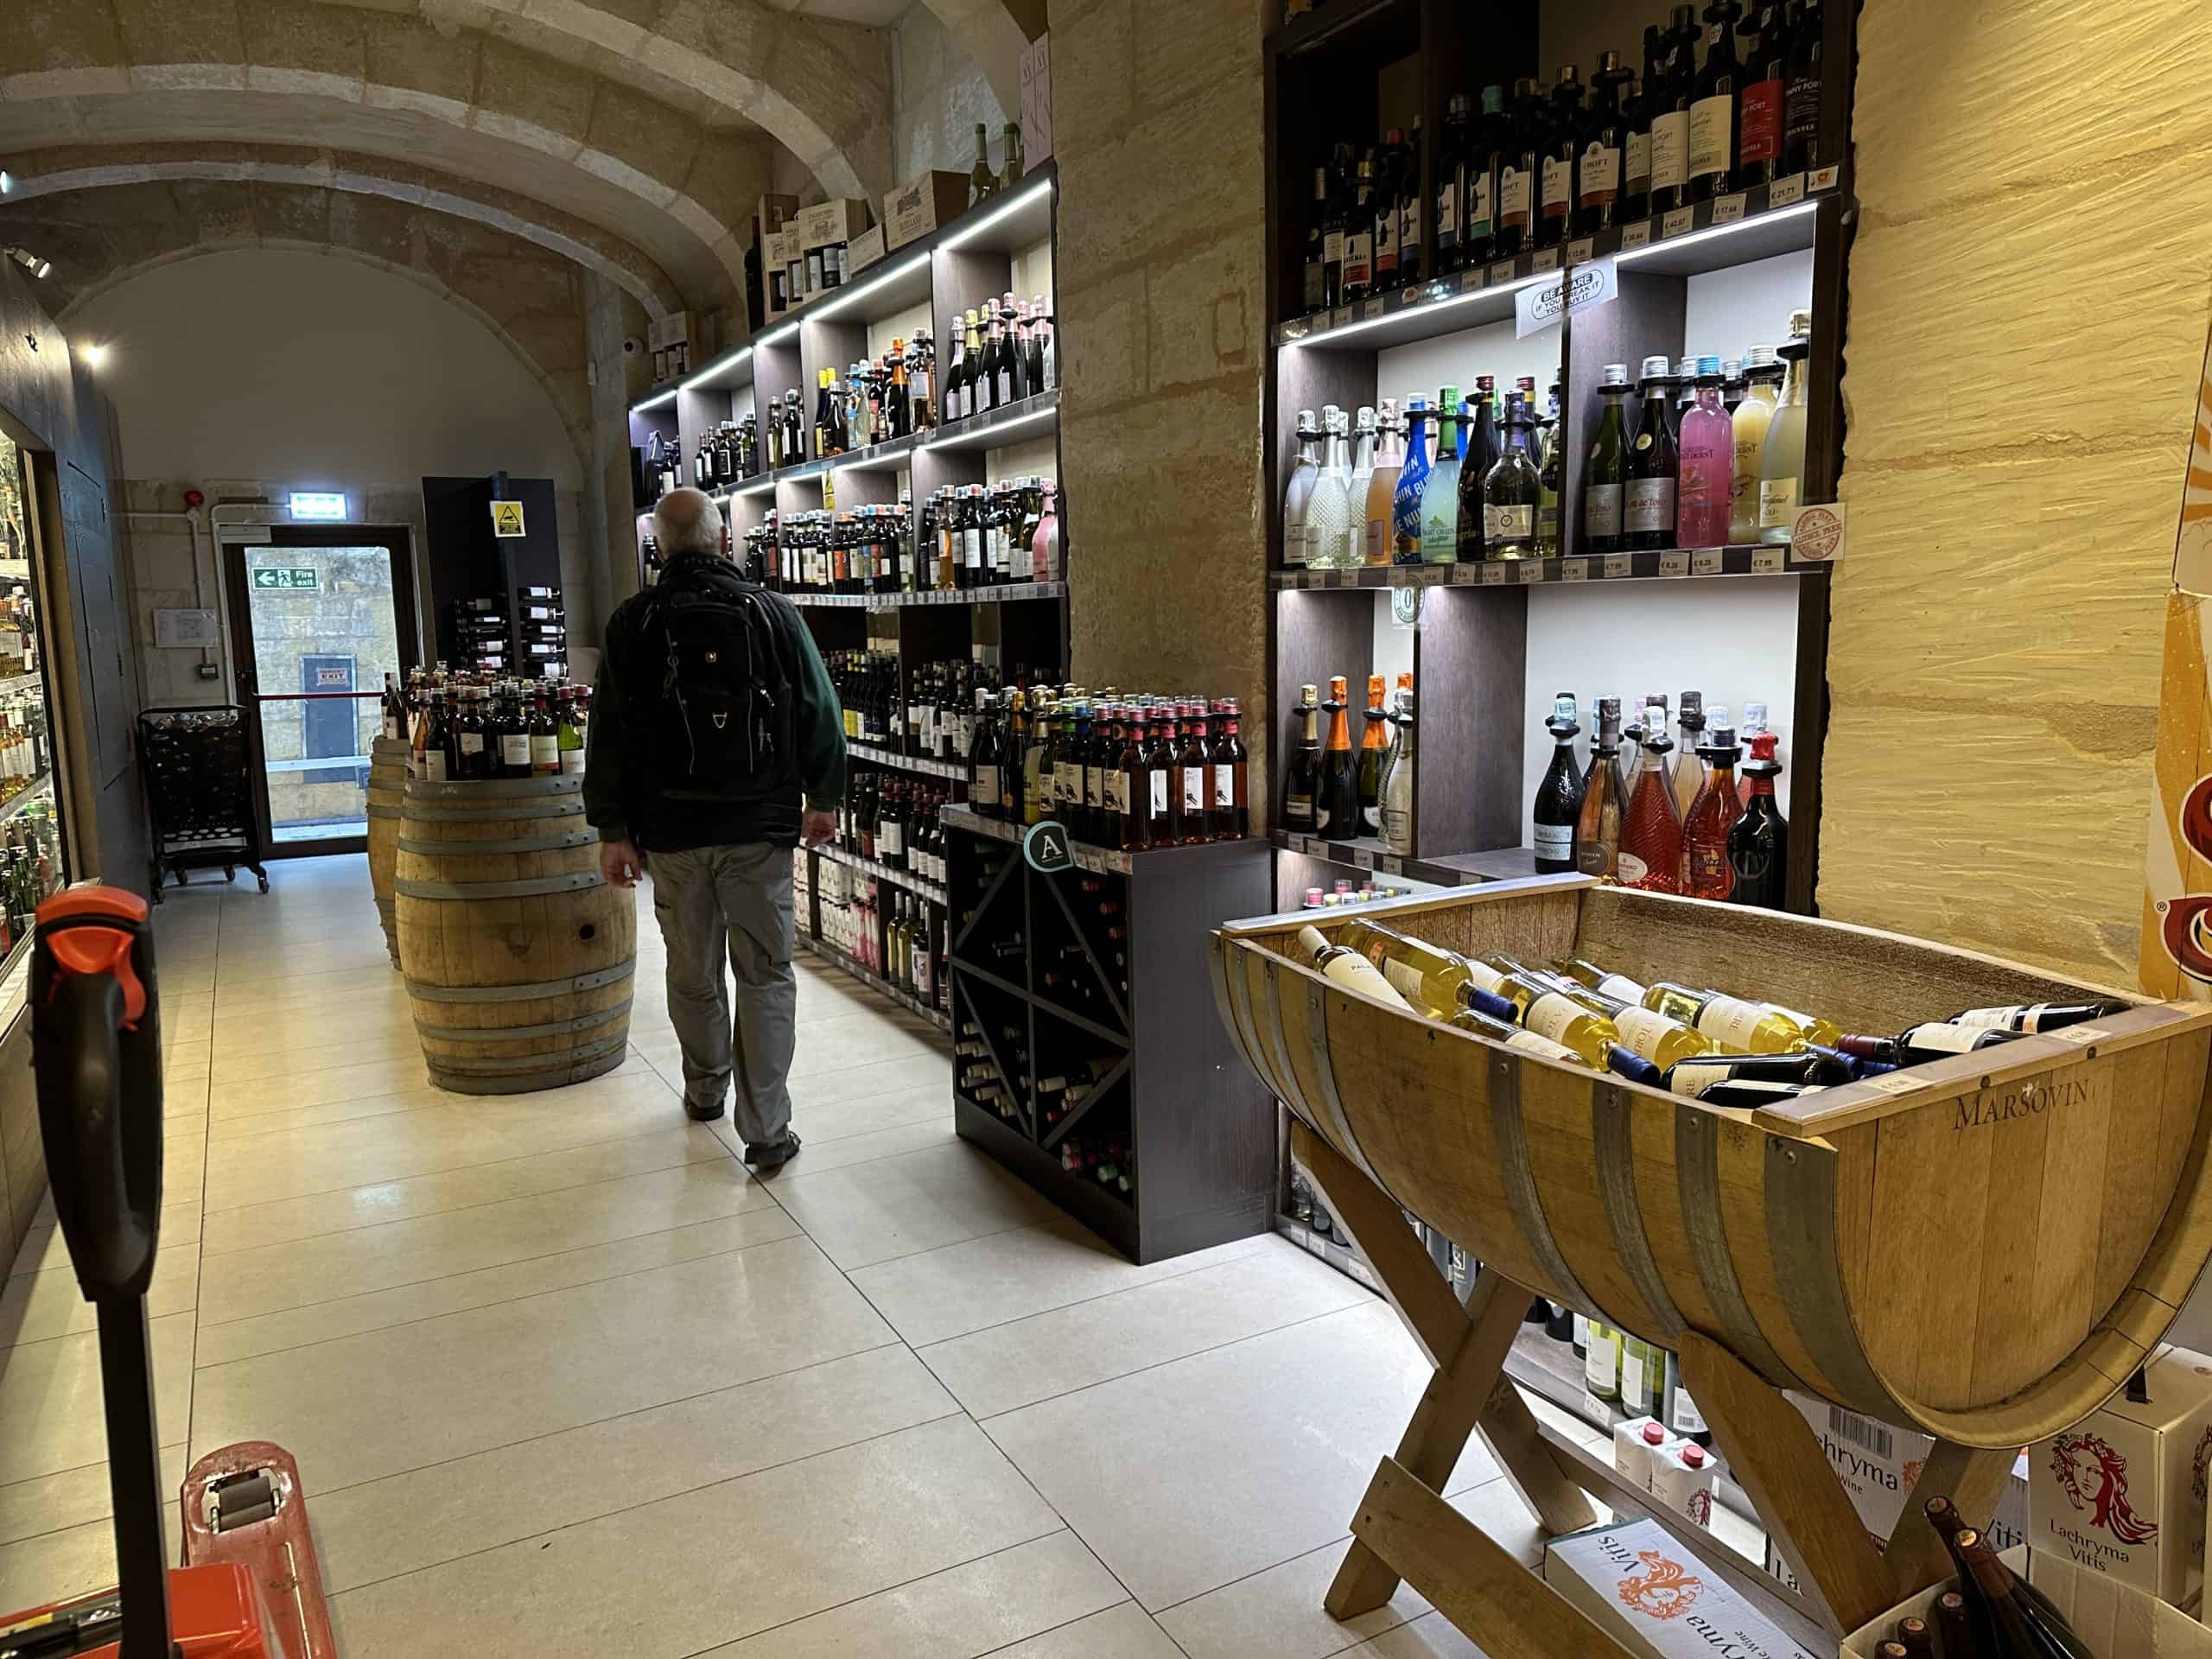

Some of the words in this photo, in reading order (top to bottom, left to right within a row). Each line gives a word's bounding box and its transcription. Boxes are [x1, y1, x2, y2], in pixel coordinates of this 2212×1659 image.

[1542, 289, 1556, 301] BE
[1557, 274, 1592, 295] AWARE
[1544, 297, 1561, 308] YOU
[1546, 302, 1562, 314] YOU
[1041, 835, 1064, 859] A
[1951, 1077, 2090, 1131] MARSOVIN
[2049, 1517, 2130, 1563] Lachryma
[1599, 1535, 1639, 1573] Vitis
[2069, 1544, 2107, 1572] Vitis
